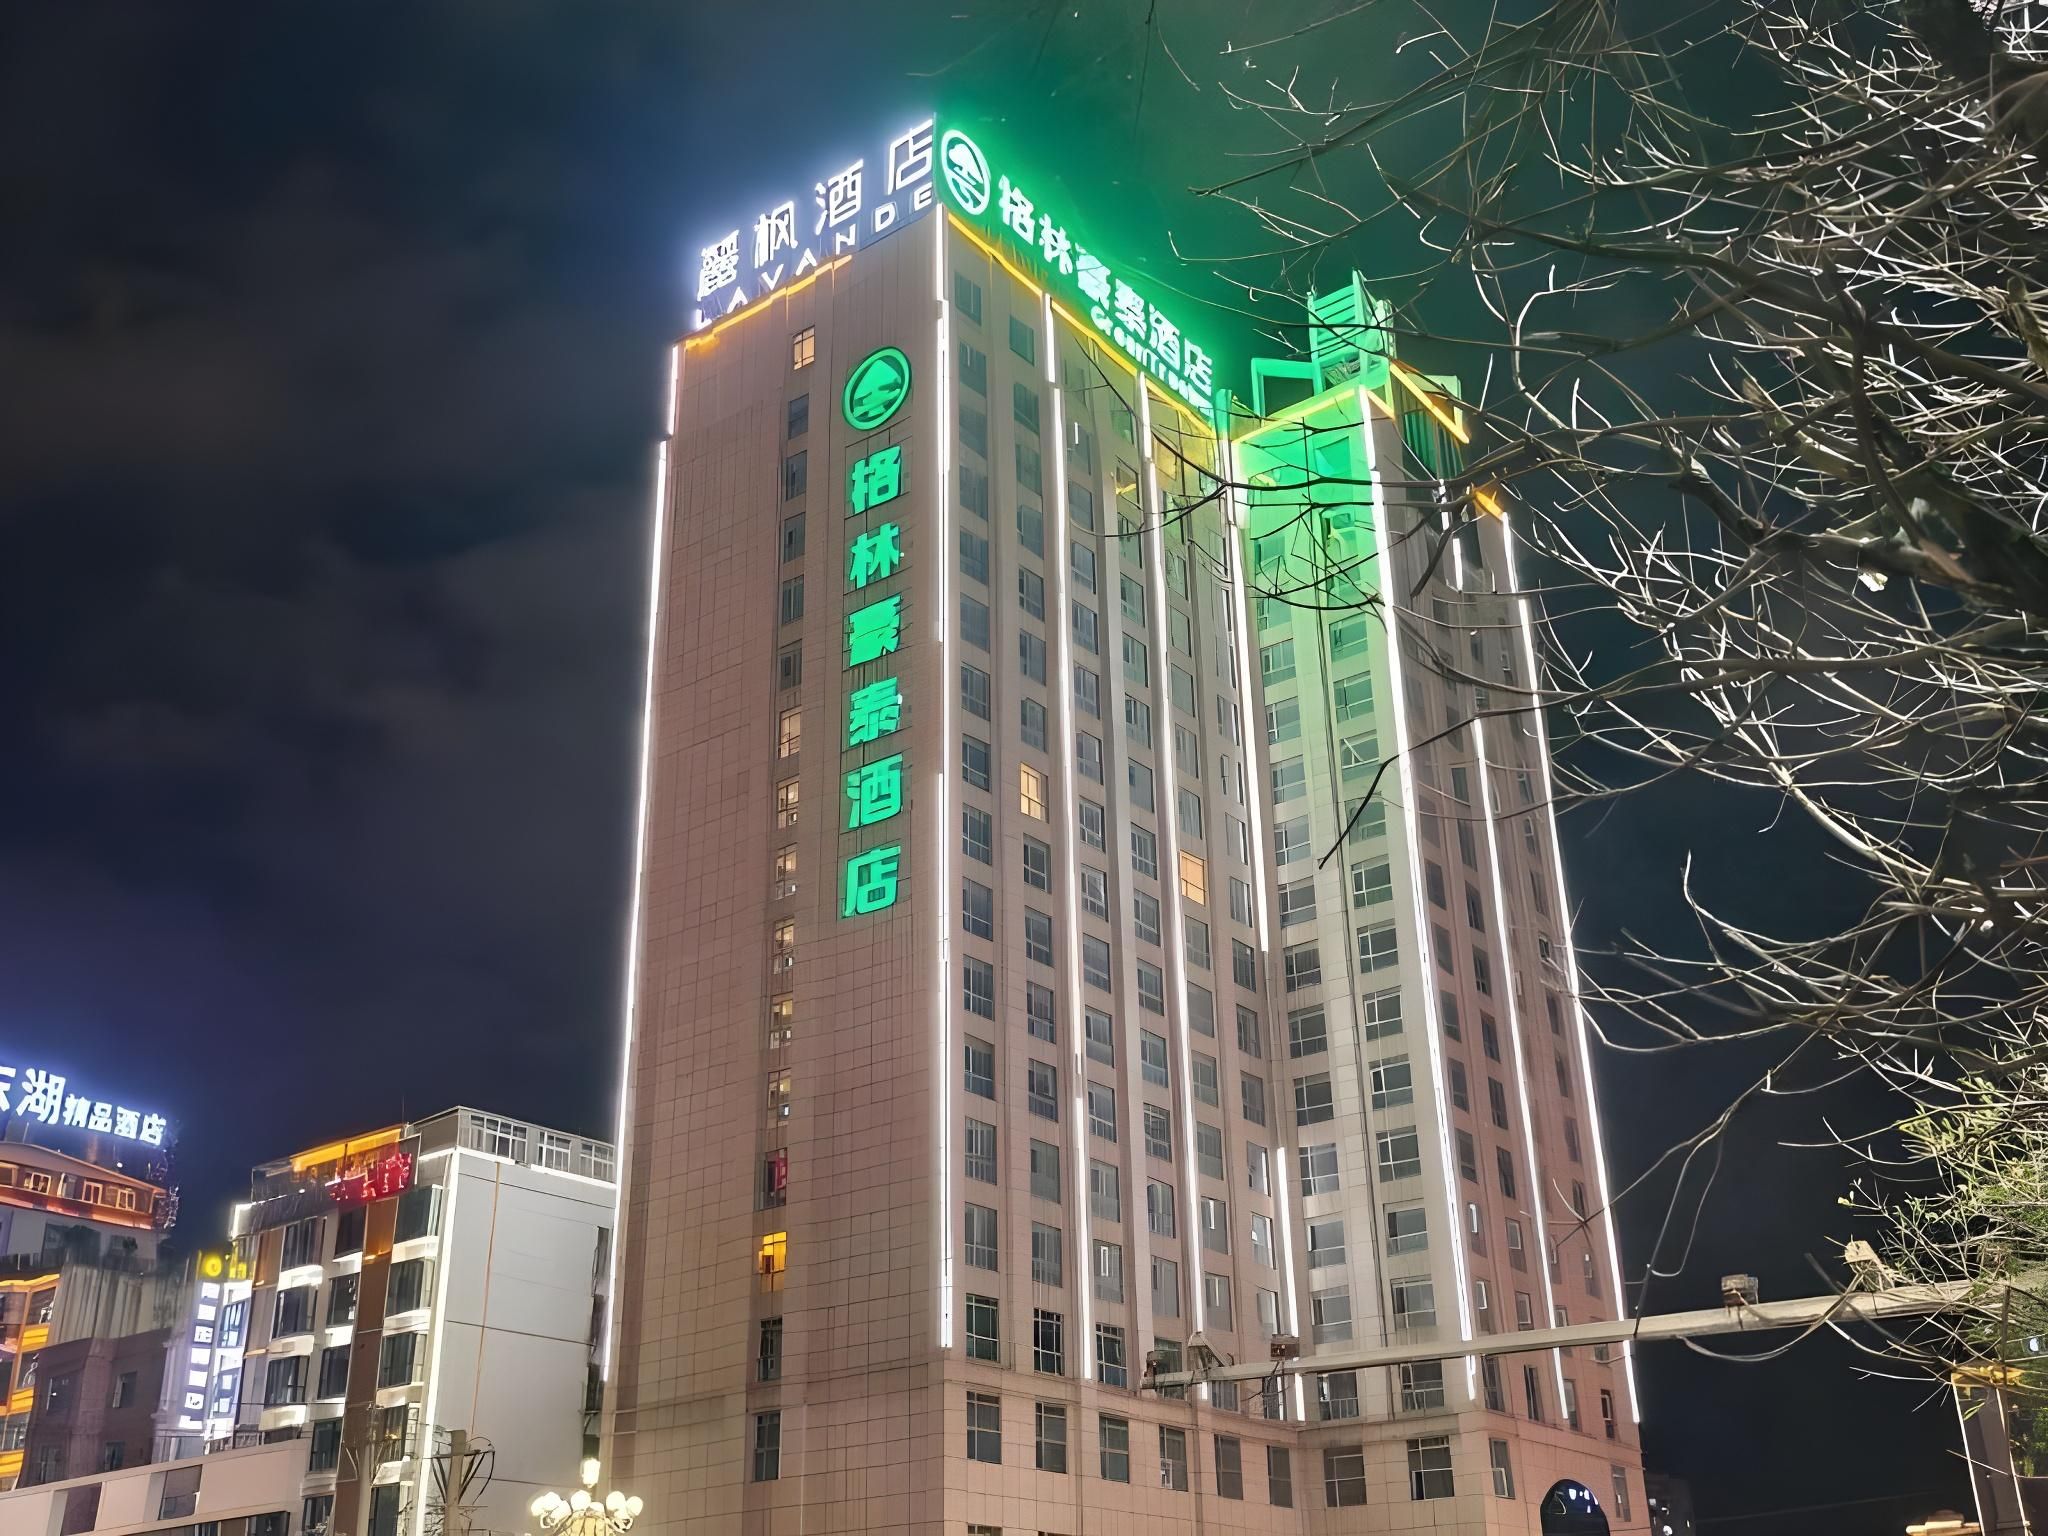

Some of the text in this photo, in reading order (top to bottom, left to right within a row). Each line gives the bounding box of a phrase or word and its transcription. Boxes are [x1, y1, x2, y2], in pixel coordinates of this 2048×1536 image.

[842, 446, 902, 918] 格林豪泰酒店
